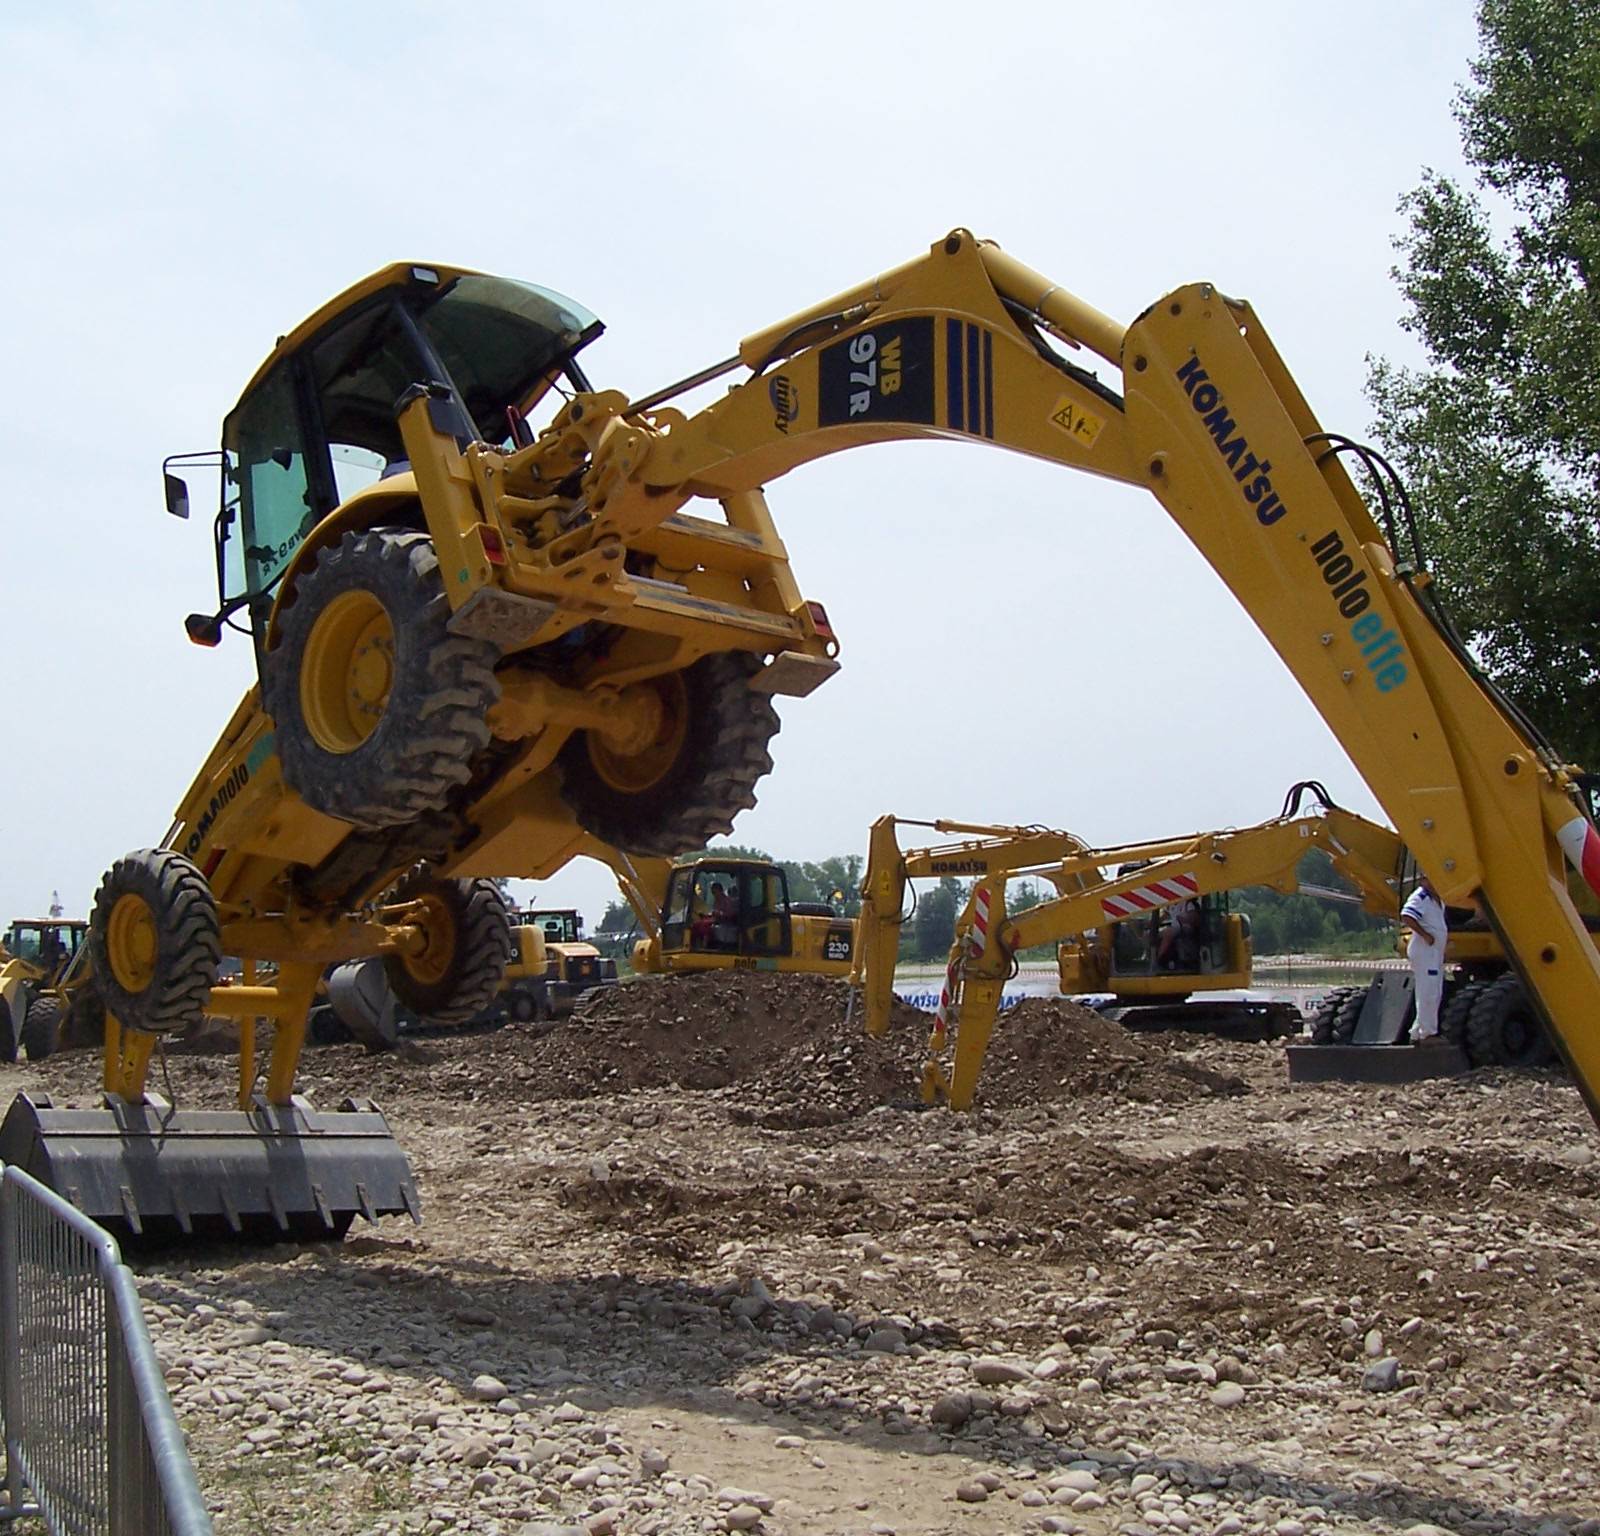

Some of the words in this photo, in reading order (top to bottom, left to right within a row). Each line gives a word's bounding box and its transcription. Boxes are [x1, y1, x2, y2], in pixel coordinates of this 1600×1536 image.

[849, 333, 878, 417] 97R
[880, 335, 902, 396] WB
[1176, 355, 1288, 527] KOMATSU
[931, 859, 988, 873] KOMATSU
[828, 942, 849, 953] 230
